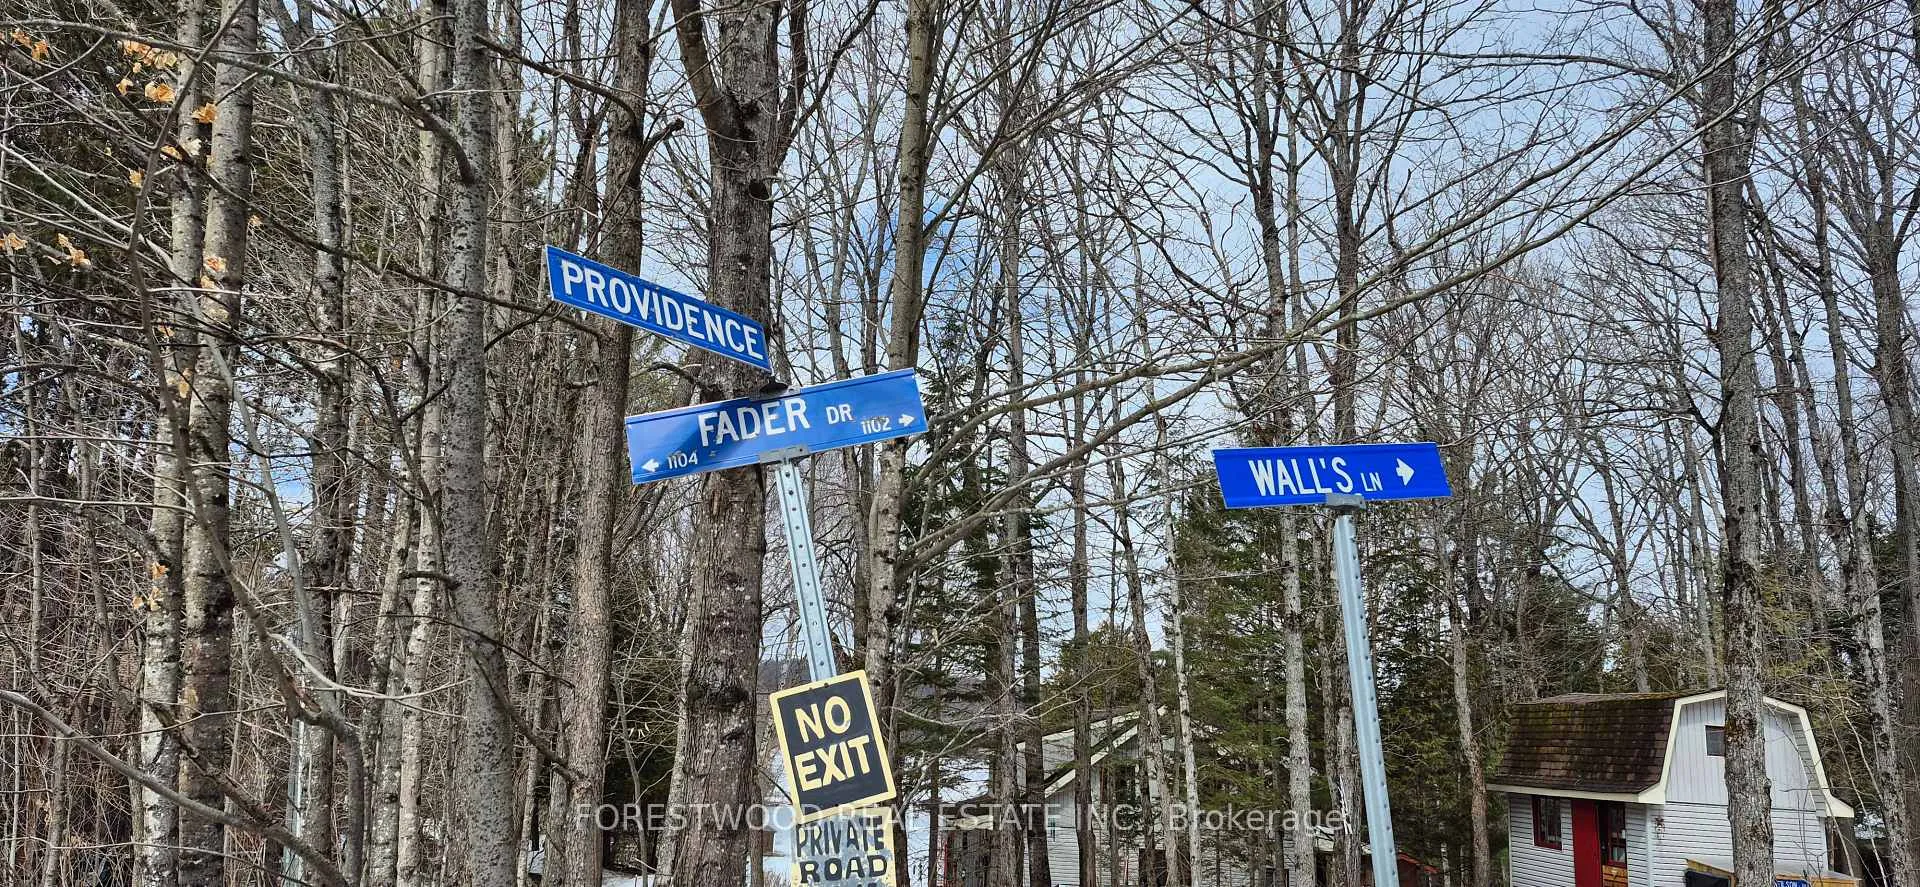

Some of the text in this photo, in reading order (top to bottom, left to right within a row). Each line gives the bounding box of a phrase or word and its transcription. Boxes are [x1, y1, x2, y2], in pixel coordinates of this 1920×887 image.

[561, 258, 765, 362] PROVIDENCE
[697, 398, 854, 448] FADER DR
[860, 417, 892, 435] 1102
[667, 452, 699, 470] 1104
[1248, 456, 1384, 497] WALL'S LN
[794, 695, 852, 743] NO
[794, 734, 871, 792] EXIT
[795, 815, 886, 858] PRIVATE
[799, 854, 888, 884] ROAD
